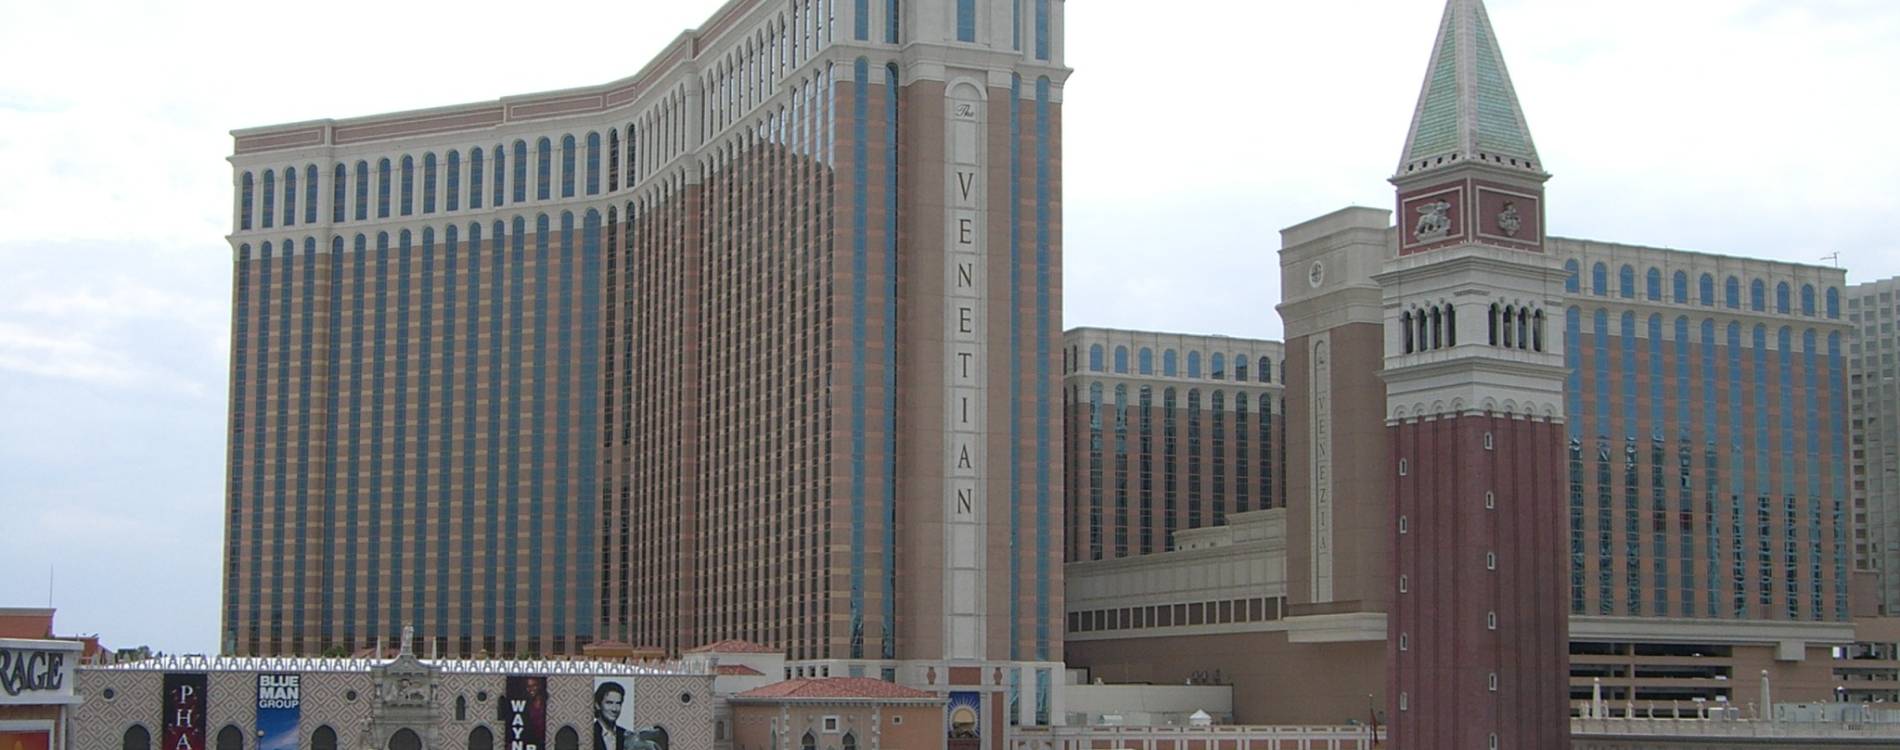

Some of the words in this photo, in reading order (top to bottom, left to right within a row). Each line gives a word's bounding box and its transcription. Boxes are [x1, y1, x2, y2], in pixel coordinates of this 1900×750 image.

[956, 172, 974, 514] VENETIAN
[1318, 397, 1329, 549] VENEZIA
[260, 675, 299, 687] BLUE
[260, 687, 299, 699] MAN
[259, 700, 299, 709] GROUP
[511, 700, 526, 750] WAYN
